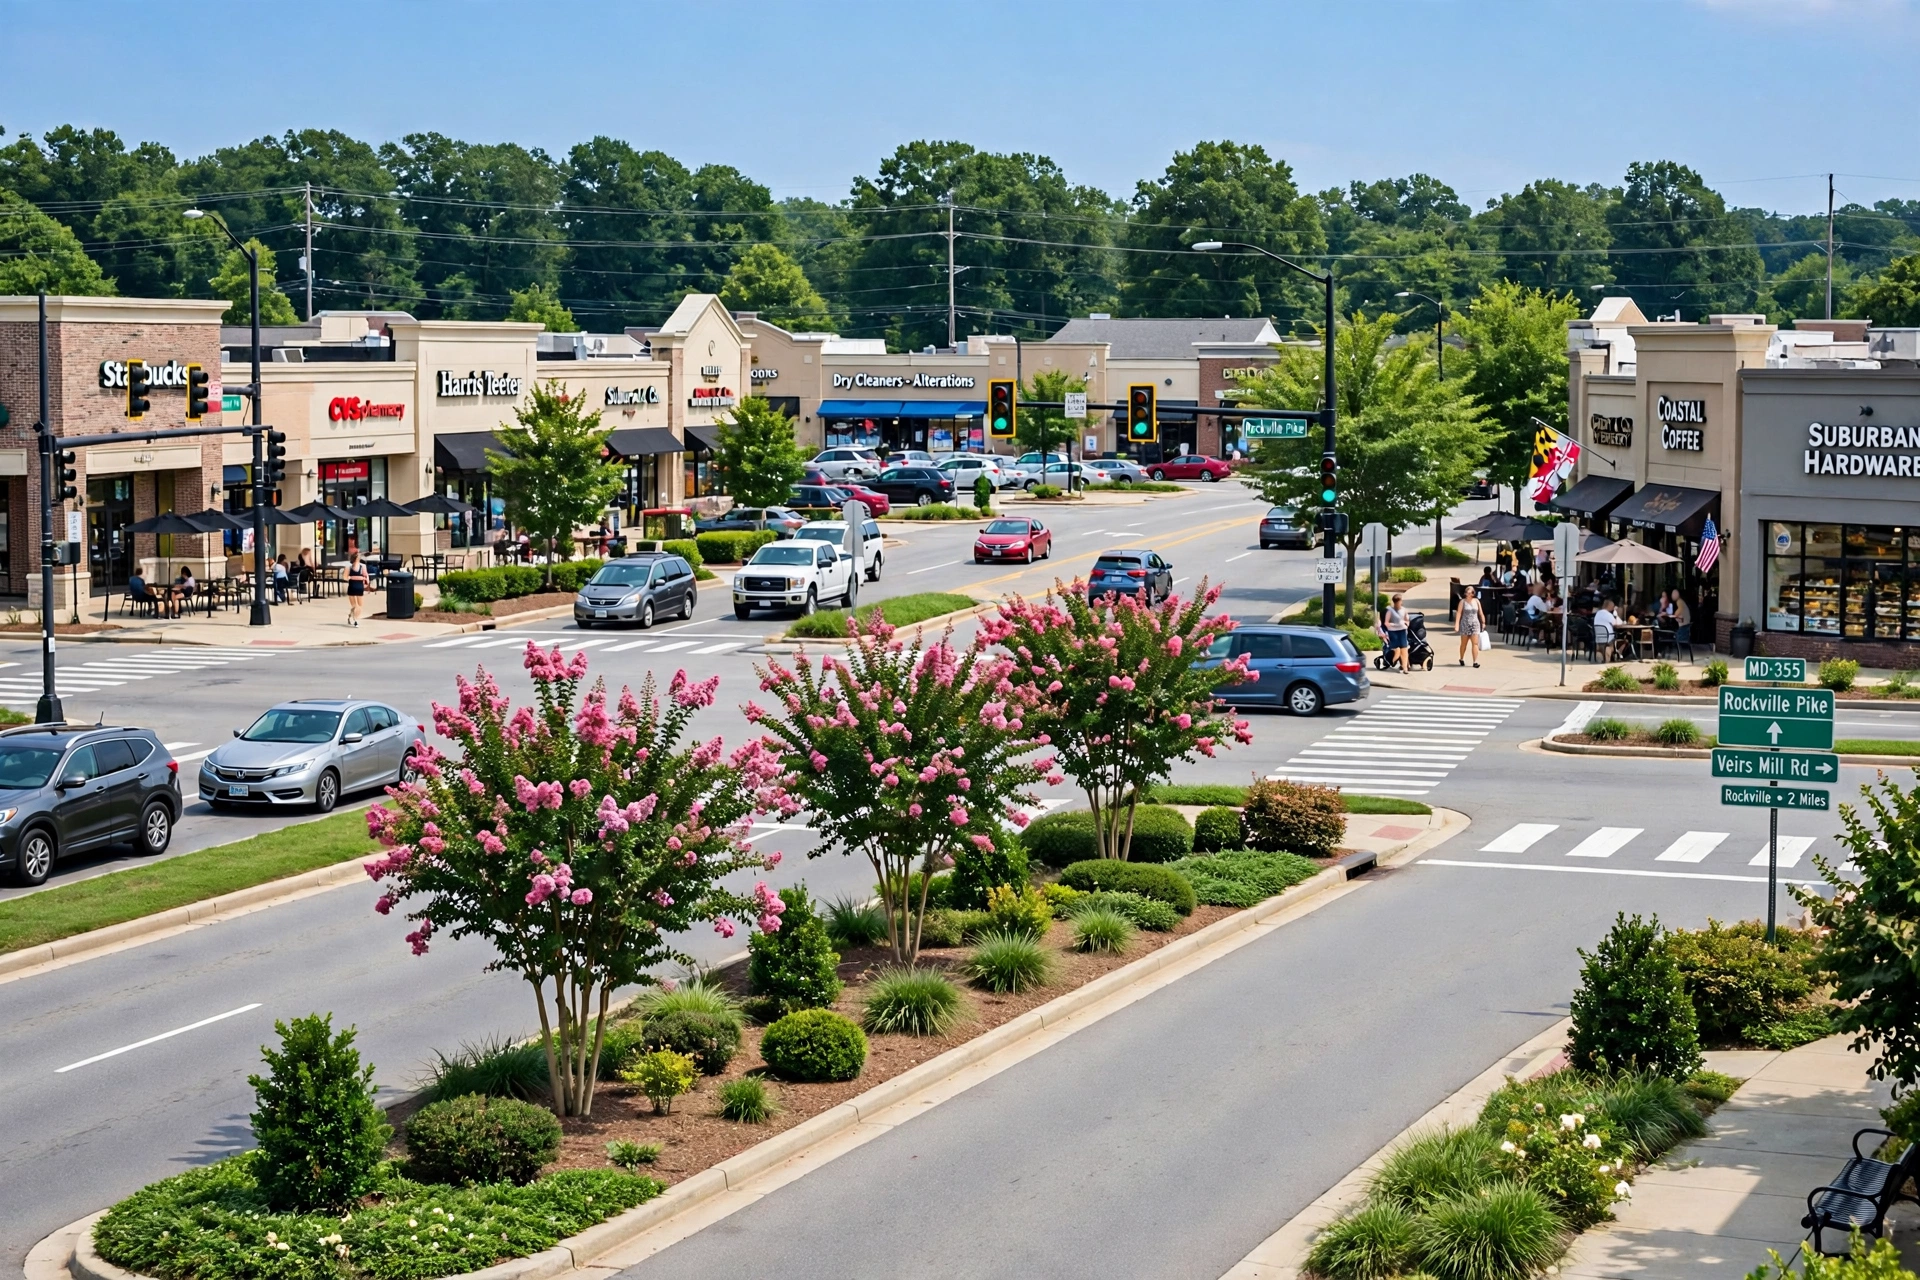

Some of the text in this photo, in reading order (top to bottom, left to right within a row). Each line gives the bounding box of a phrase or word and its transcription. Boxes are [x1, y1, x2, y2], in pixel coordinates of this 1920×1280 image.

[439, 370, 522, 397] Harris Teeter
[833, 373, 853, 390] Dry
[855, 373, 903, 388] Cleaners
[912, 373, 975, 388] Alterations
[328, 396, 361, 422] CVS
[1657, 396, 1704, 423] COASTAL
[1661, 424, 1701, 451] COFFEE
[1808, 422, 1920, 448] SUBURBAN
[1724, 692, 1828, 714] Rockville Pike
[1717, 755, 1809, 776] Veirs Mill Rd
[1725, 788, 1772, 804] Rockville
[1787, 792, 1796, 805] 2
[1799, 792, 1826, 807] Miles
